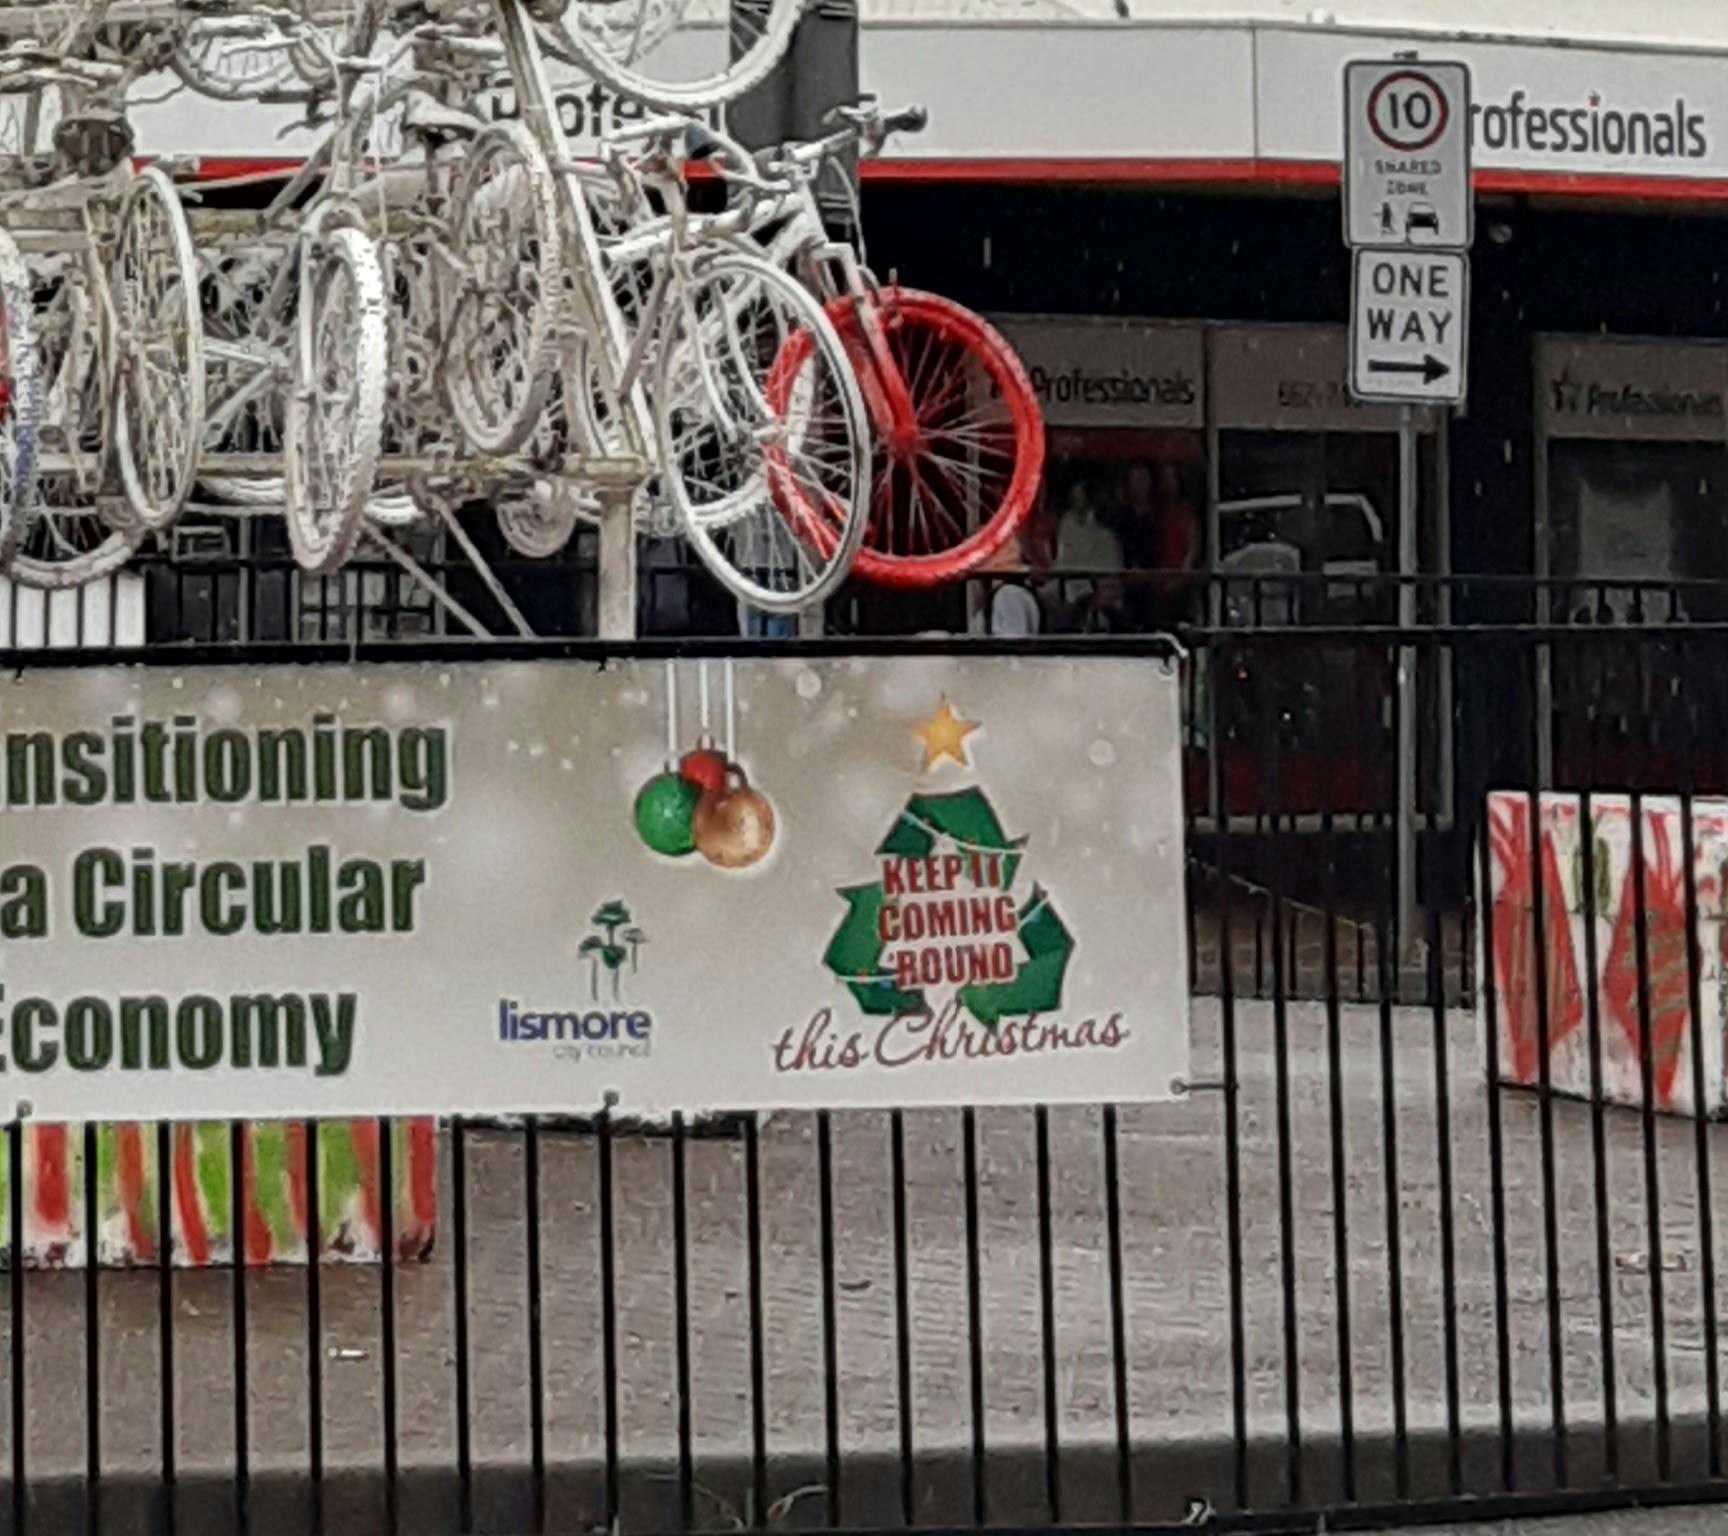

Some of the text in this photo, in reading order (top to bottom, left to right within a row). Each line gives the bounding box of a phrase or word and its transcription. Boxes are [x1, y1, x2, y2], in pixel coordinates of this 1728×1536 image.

[1388, 91, 1432, 129] 10
[1471, 91, 1706, 158] rofessionals
[1372, 262, 1450, 298] ONE
[1366, 307, 1453, 345] WAY
[73, 843, 426, 939] Circular
[882, 850, 1004, 895] KEEP IT
[878, 894, 1017, 943] COMING
[498, 998, 653, 1041] lismore
[773, 996, 1131, 1072] this Christmas
